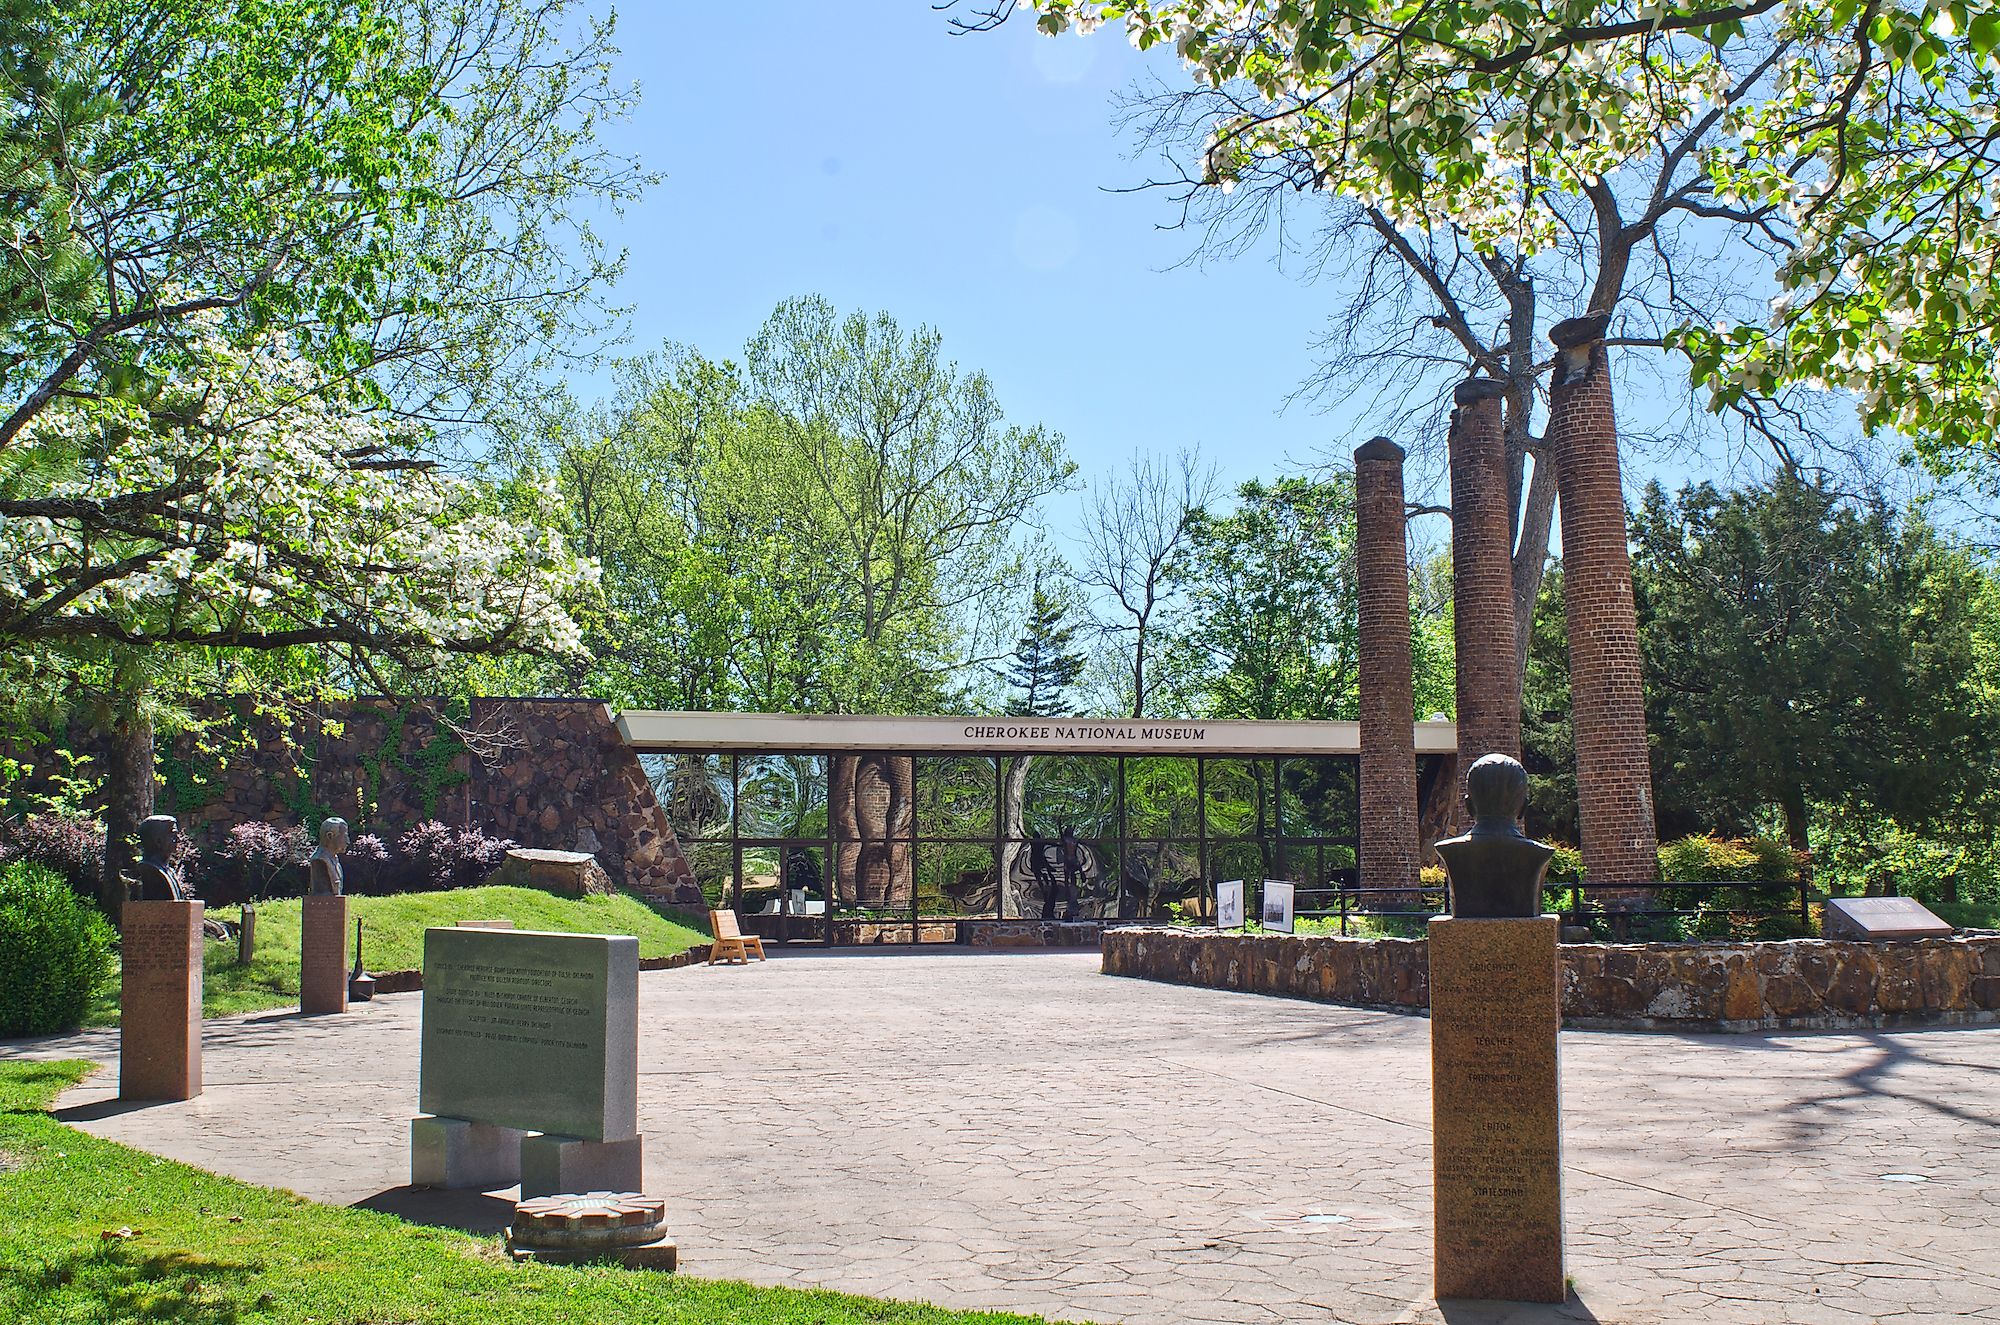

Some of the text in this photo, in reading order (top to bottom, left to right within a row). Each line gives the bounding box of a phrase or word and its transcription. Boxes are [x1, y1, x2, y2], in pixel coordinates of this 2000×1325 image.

[964, 726, 1206, 740] CHEROKEE NATIONAL MUSEUM
[1475, 1036, 1514, 1046] TEACHER
[1482, 1122, 1512, 1131] EDITOR
[1472, 1187, 1524, 1197] STATESMAN
